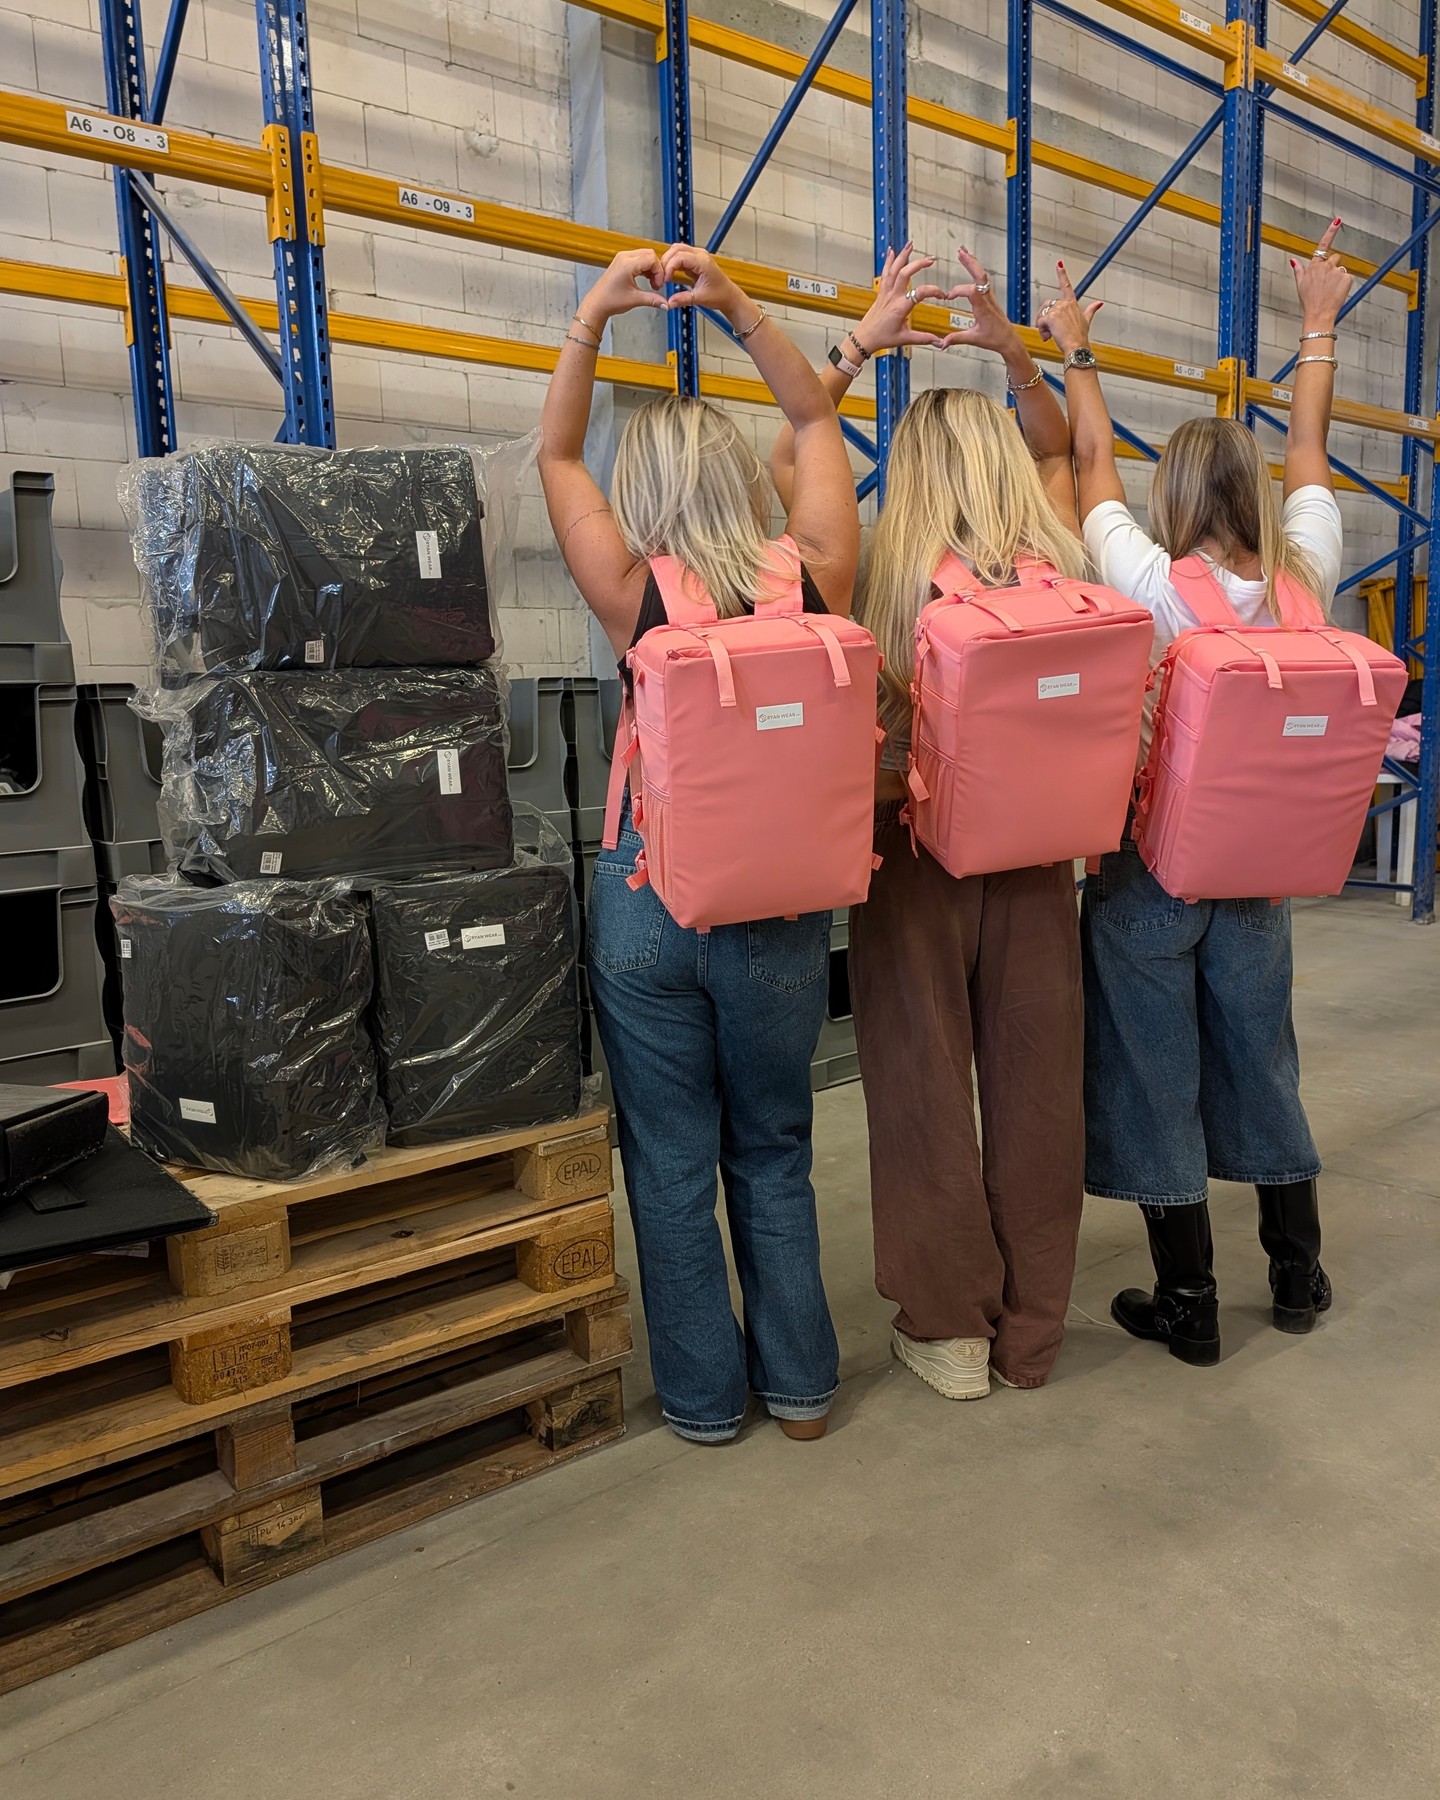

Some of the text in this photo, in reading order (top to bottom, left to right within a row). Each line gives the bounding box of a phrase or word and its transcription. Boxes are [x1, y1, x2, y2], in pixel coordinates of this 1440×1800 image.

[70, 116, 92, 132] A6
[156, 135, 166, 149] 3
[401, 191, 418, 206] A6
[465, 206, 472, 218] 3
[789, 278, 800, 289] A6
[811, 282, 821, 293] 10
[831, 286, 836, 296] 3
[564, 1158, 597, 1181] EPAL
[562, 1246, 602, 1275] EPAL
